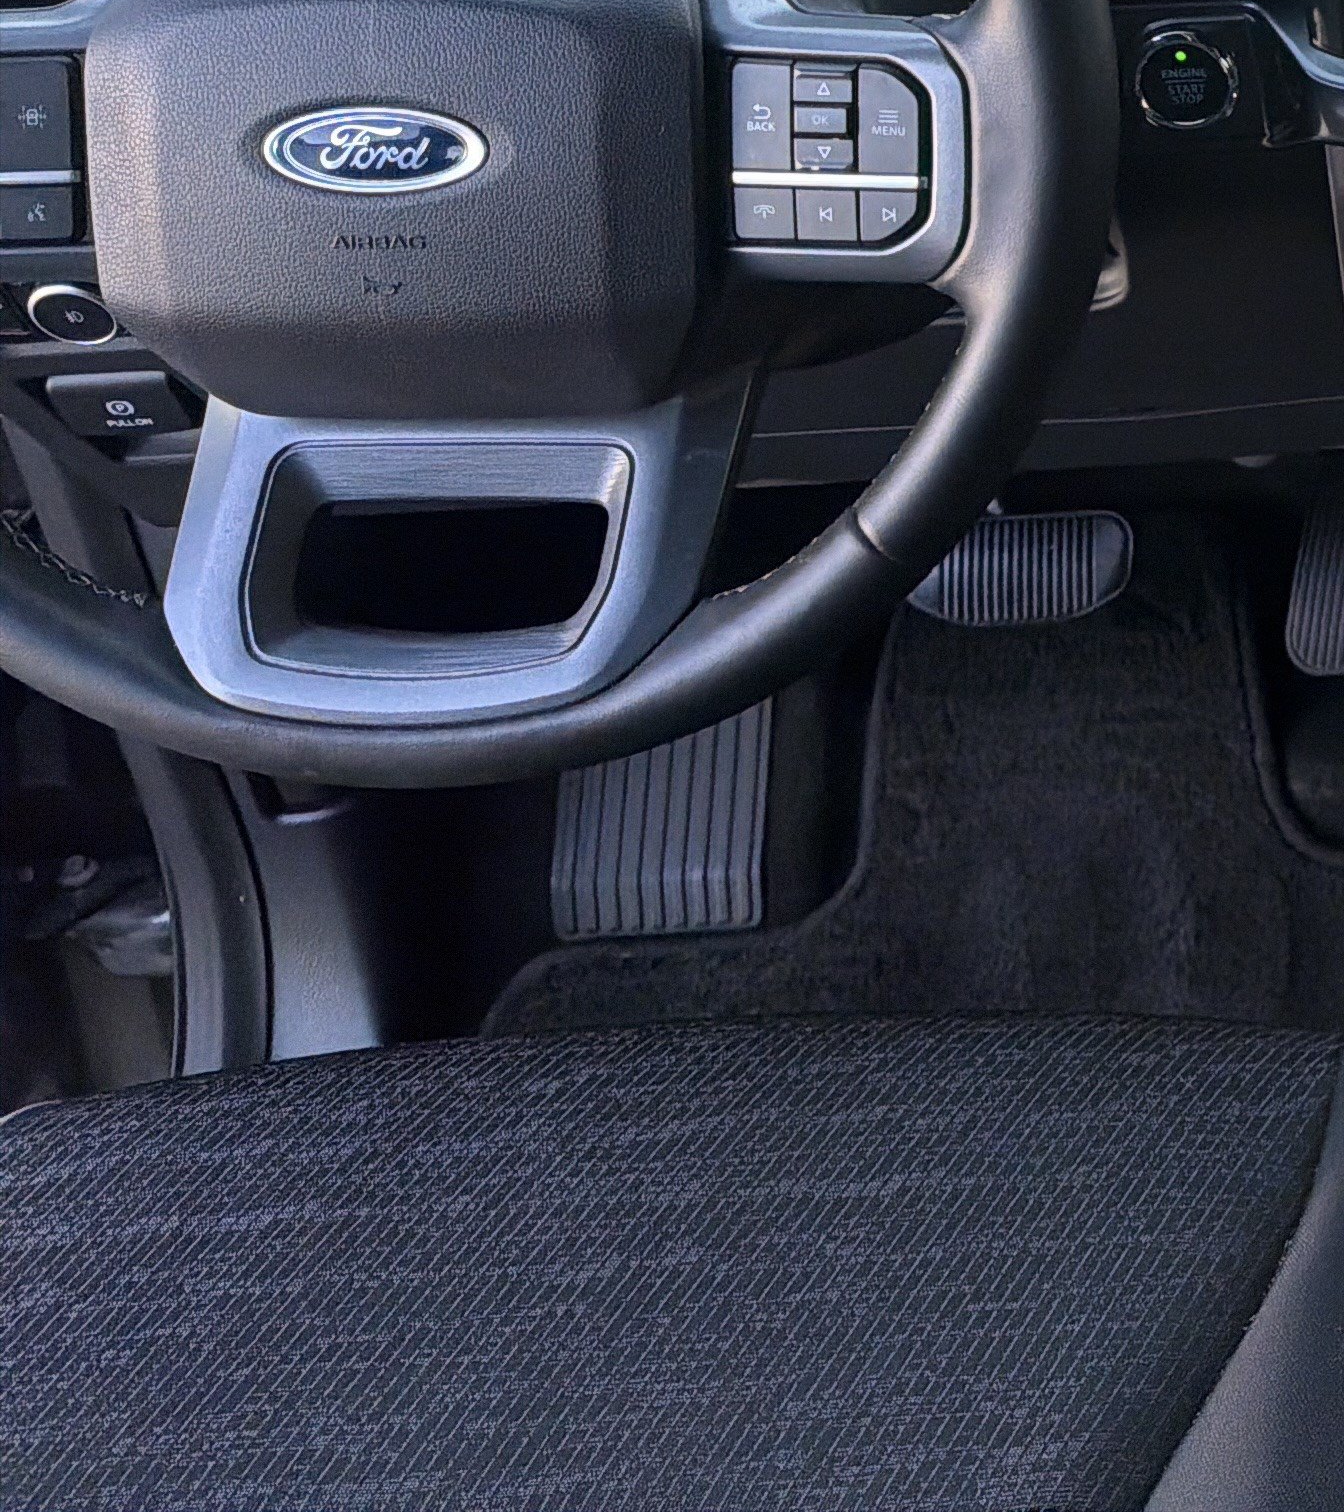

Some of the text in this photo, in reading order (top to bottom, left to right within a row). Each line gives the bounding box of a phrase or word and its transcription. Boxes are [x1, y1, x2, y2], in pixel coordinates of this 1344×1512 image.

[1160, 68, 1208, 80] ENGINE
[1167, 84, 1206, 95] START
[1171, 94, 1204, 105] STOP
[746, 120, 776, 132] BACK
[811, 114, 830, 126] OK
[871, 125, 906, 136] MENU
[319, 124, 431, 170] Ford
